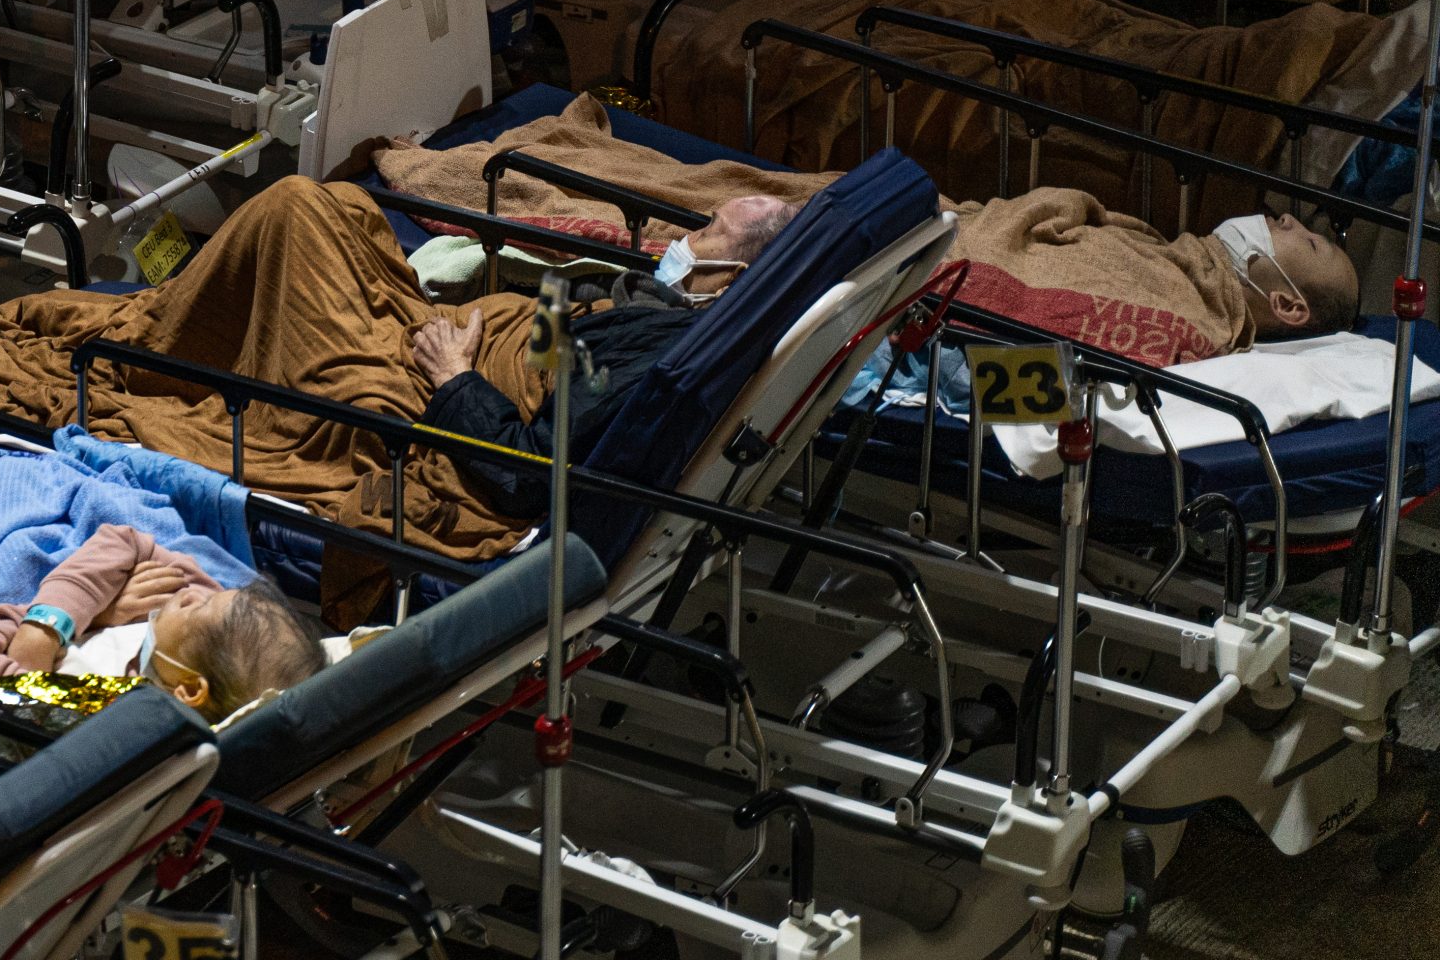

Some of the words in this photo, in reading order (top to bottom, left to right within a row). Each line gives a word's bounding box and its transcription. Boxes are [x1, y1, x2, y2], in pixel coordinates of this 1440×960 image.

[141, 239, 157, 259] CEU
[147, 260, 166, 283] EAM:
[976, 361, 1066, 415] 23
